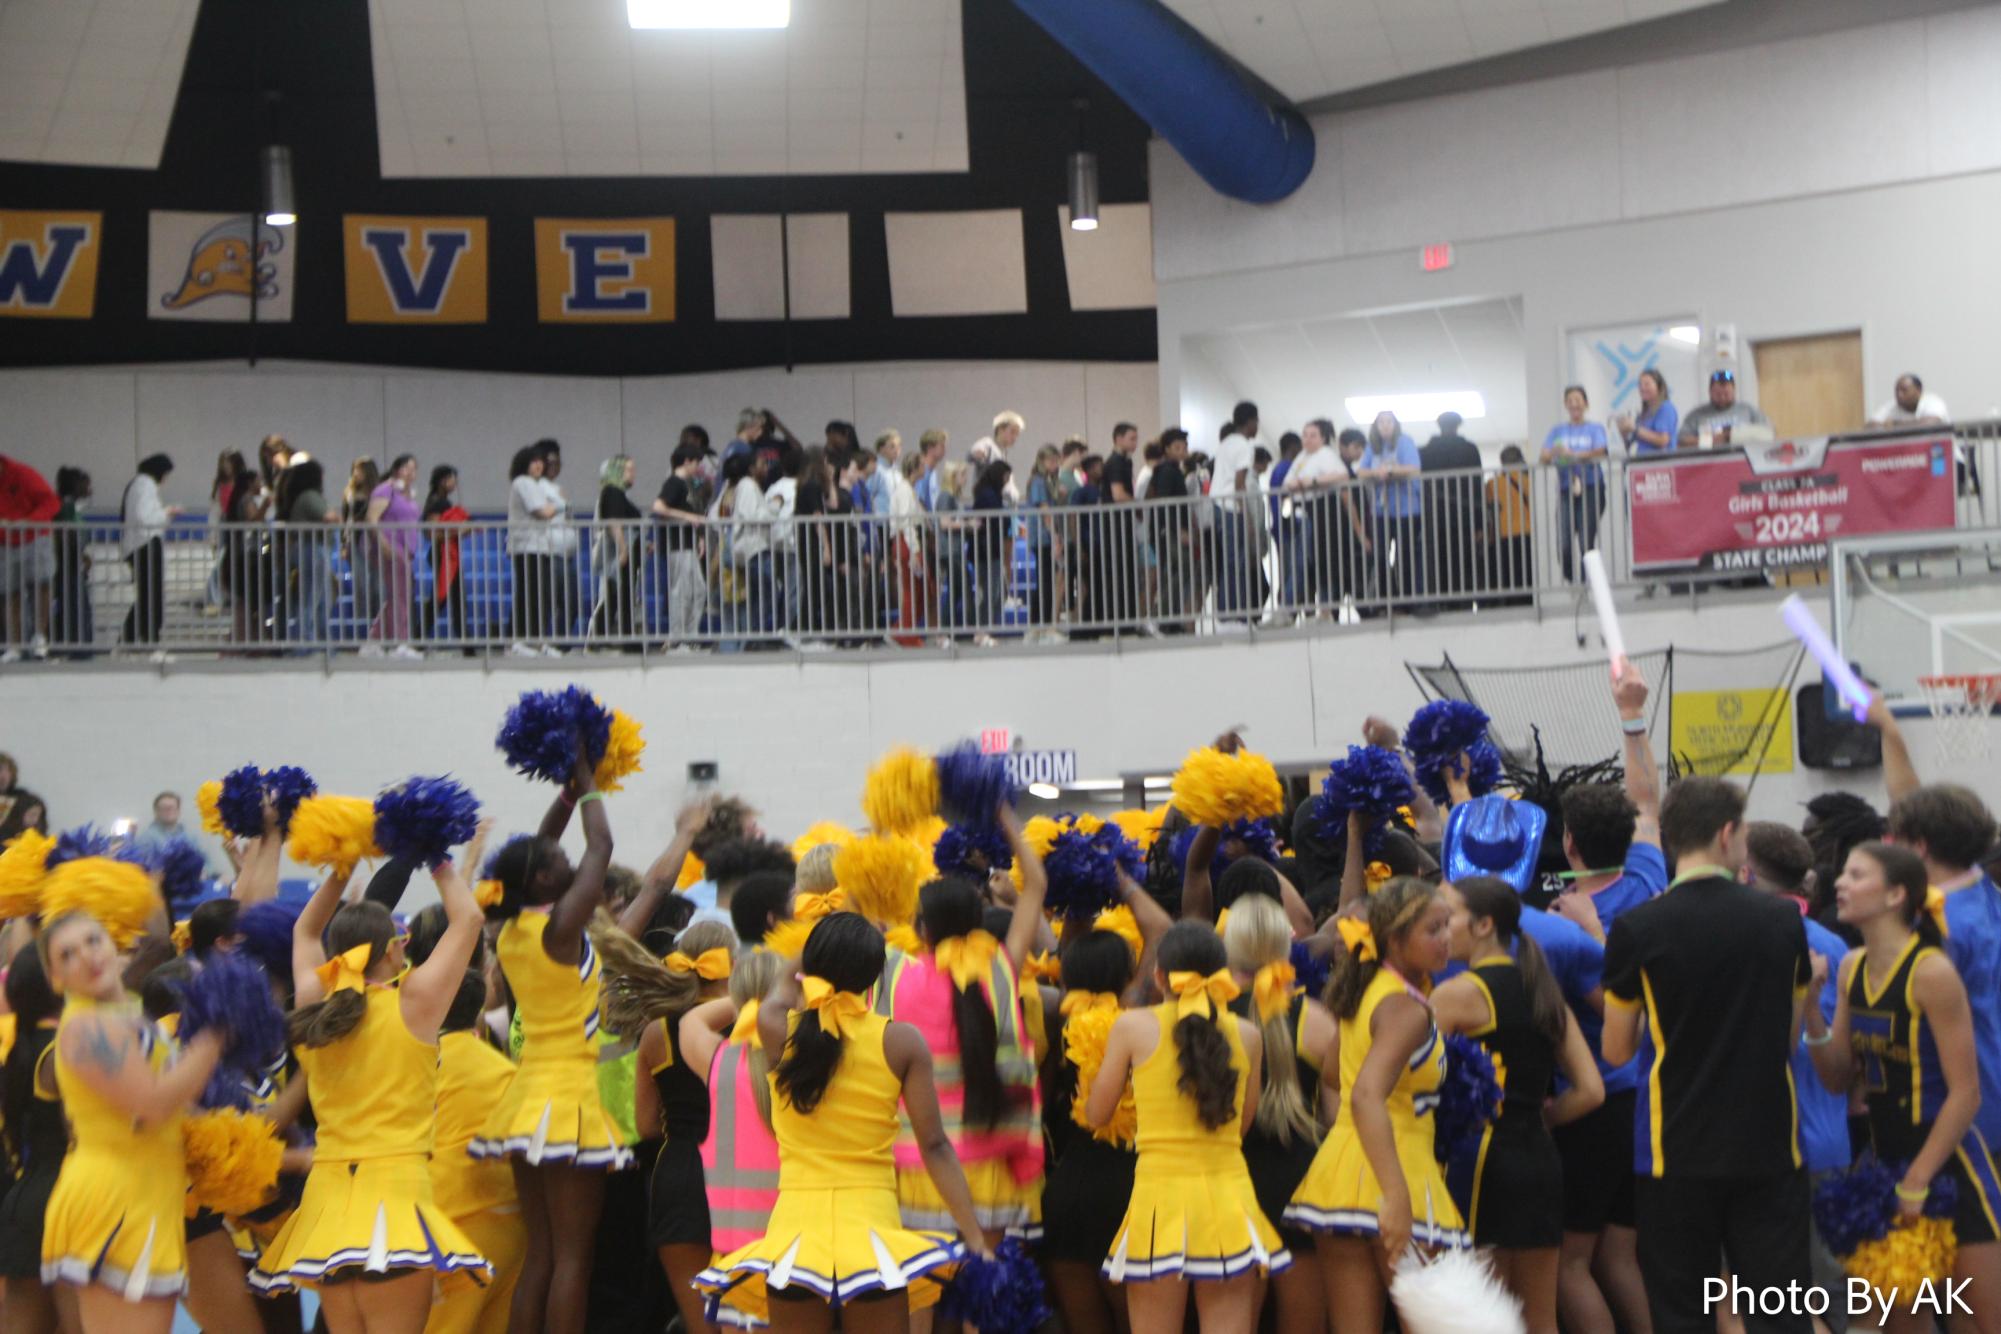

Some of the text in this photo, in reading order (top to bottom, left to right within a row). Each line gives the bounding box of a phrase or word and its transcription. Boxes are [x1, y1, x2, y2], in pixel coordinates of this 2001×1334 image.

[362, 224, 470, 314] V
[560, 228, 652, 315] E
[1728, 485, 1848, 513] Girls Basketball
[1755, 510, 1819, 542] 2024
[1713, 543, 1827, 571] STATE CHAMP
[1004, 751, 1075, 785] ROOM
[1541, 872, 1565, 892] 25
